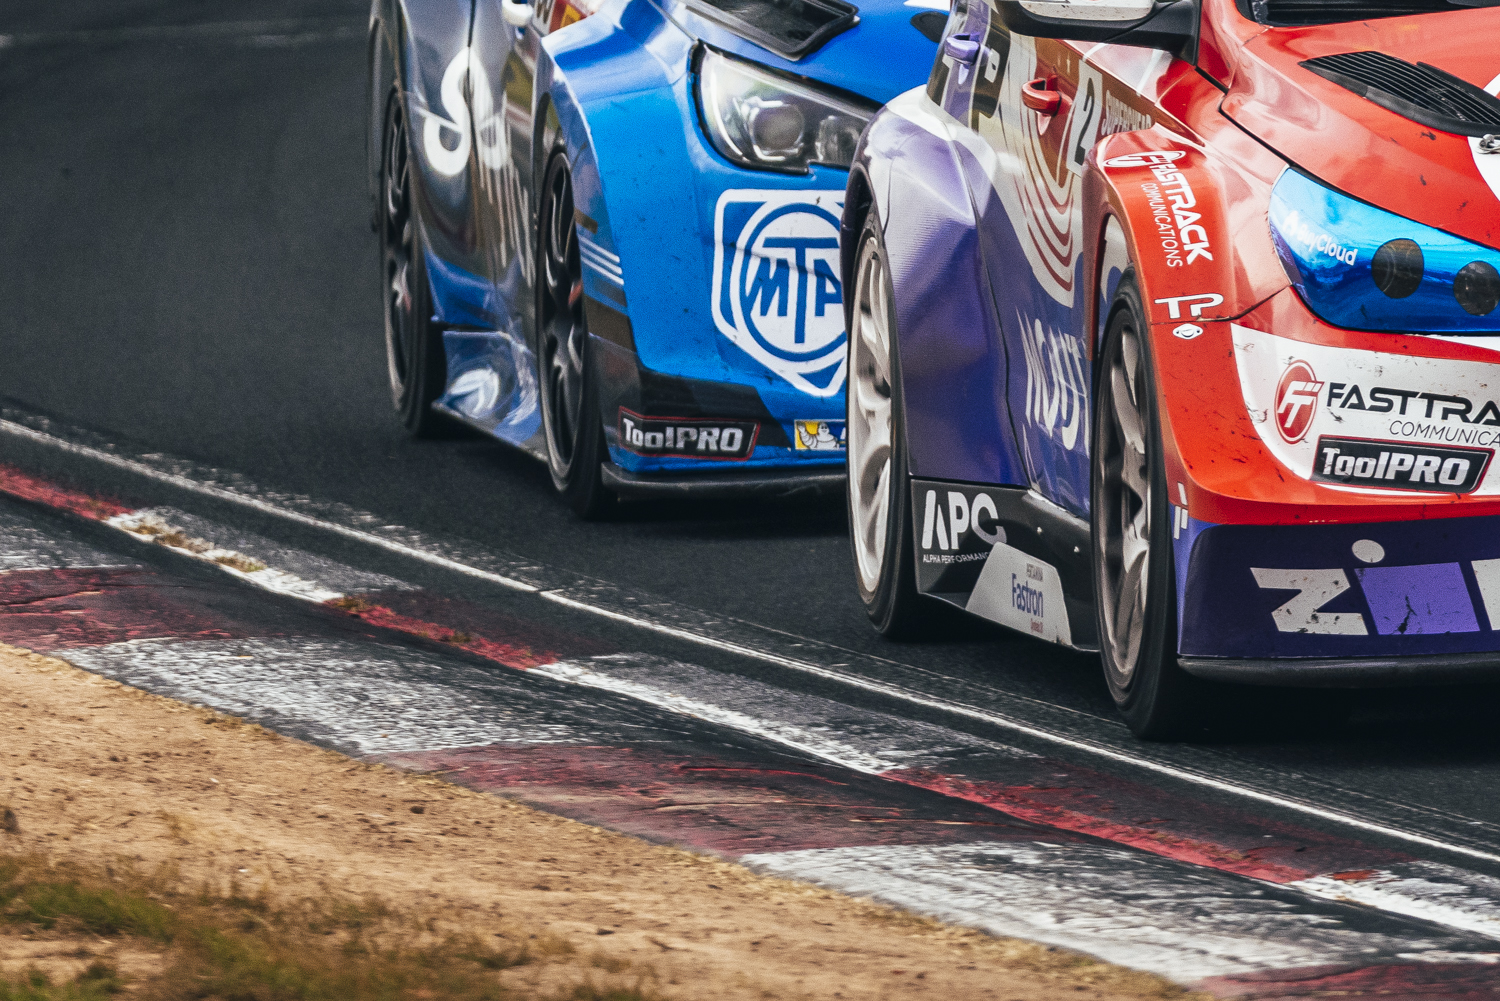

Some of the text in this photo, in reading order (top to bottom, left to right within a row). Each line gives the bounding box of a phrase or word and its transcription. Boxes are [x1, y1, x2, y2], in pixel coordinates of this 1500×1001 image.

[1074, 77, 1095, 167] 2
[622, 418, 743, 451] ToolPRO
[1321, 447, 1471, 486] ToolPRO
[1011, 573, 1044, 618] Fastron
